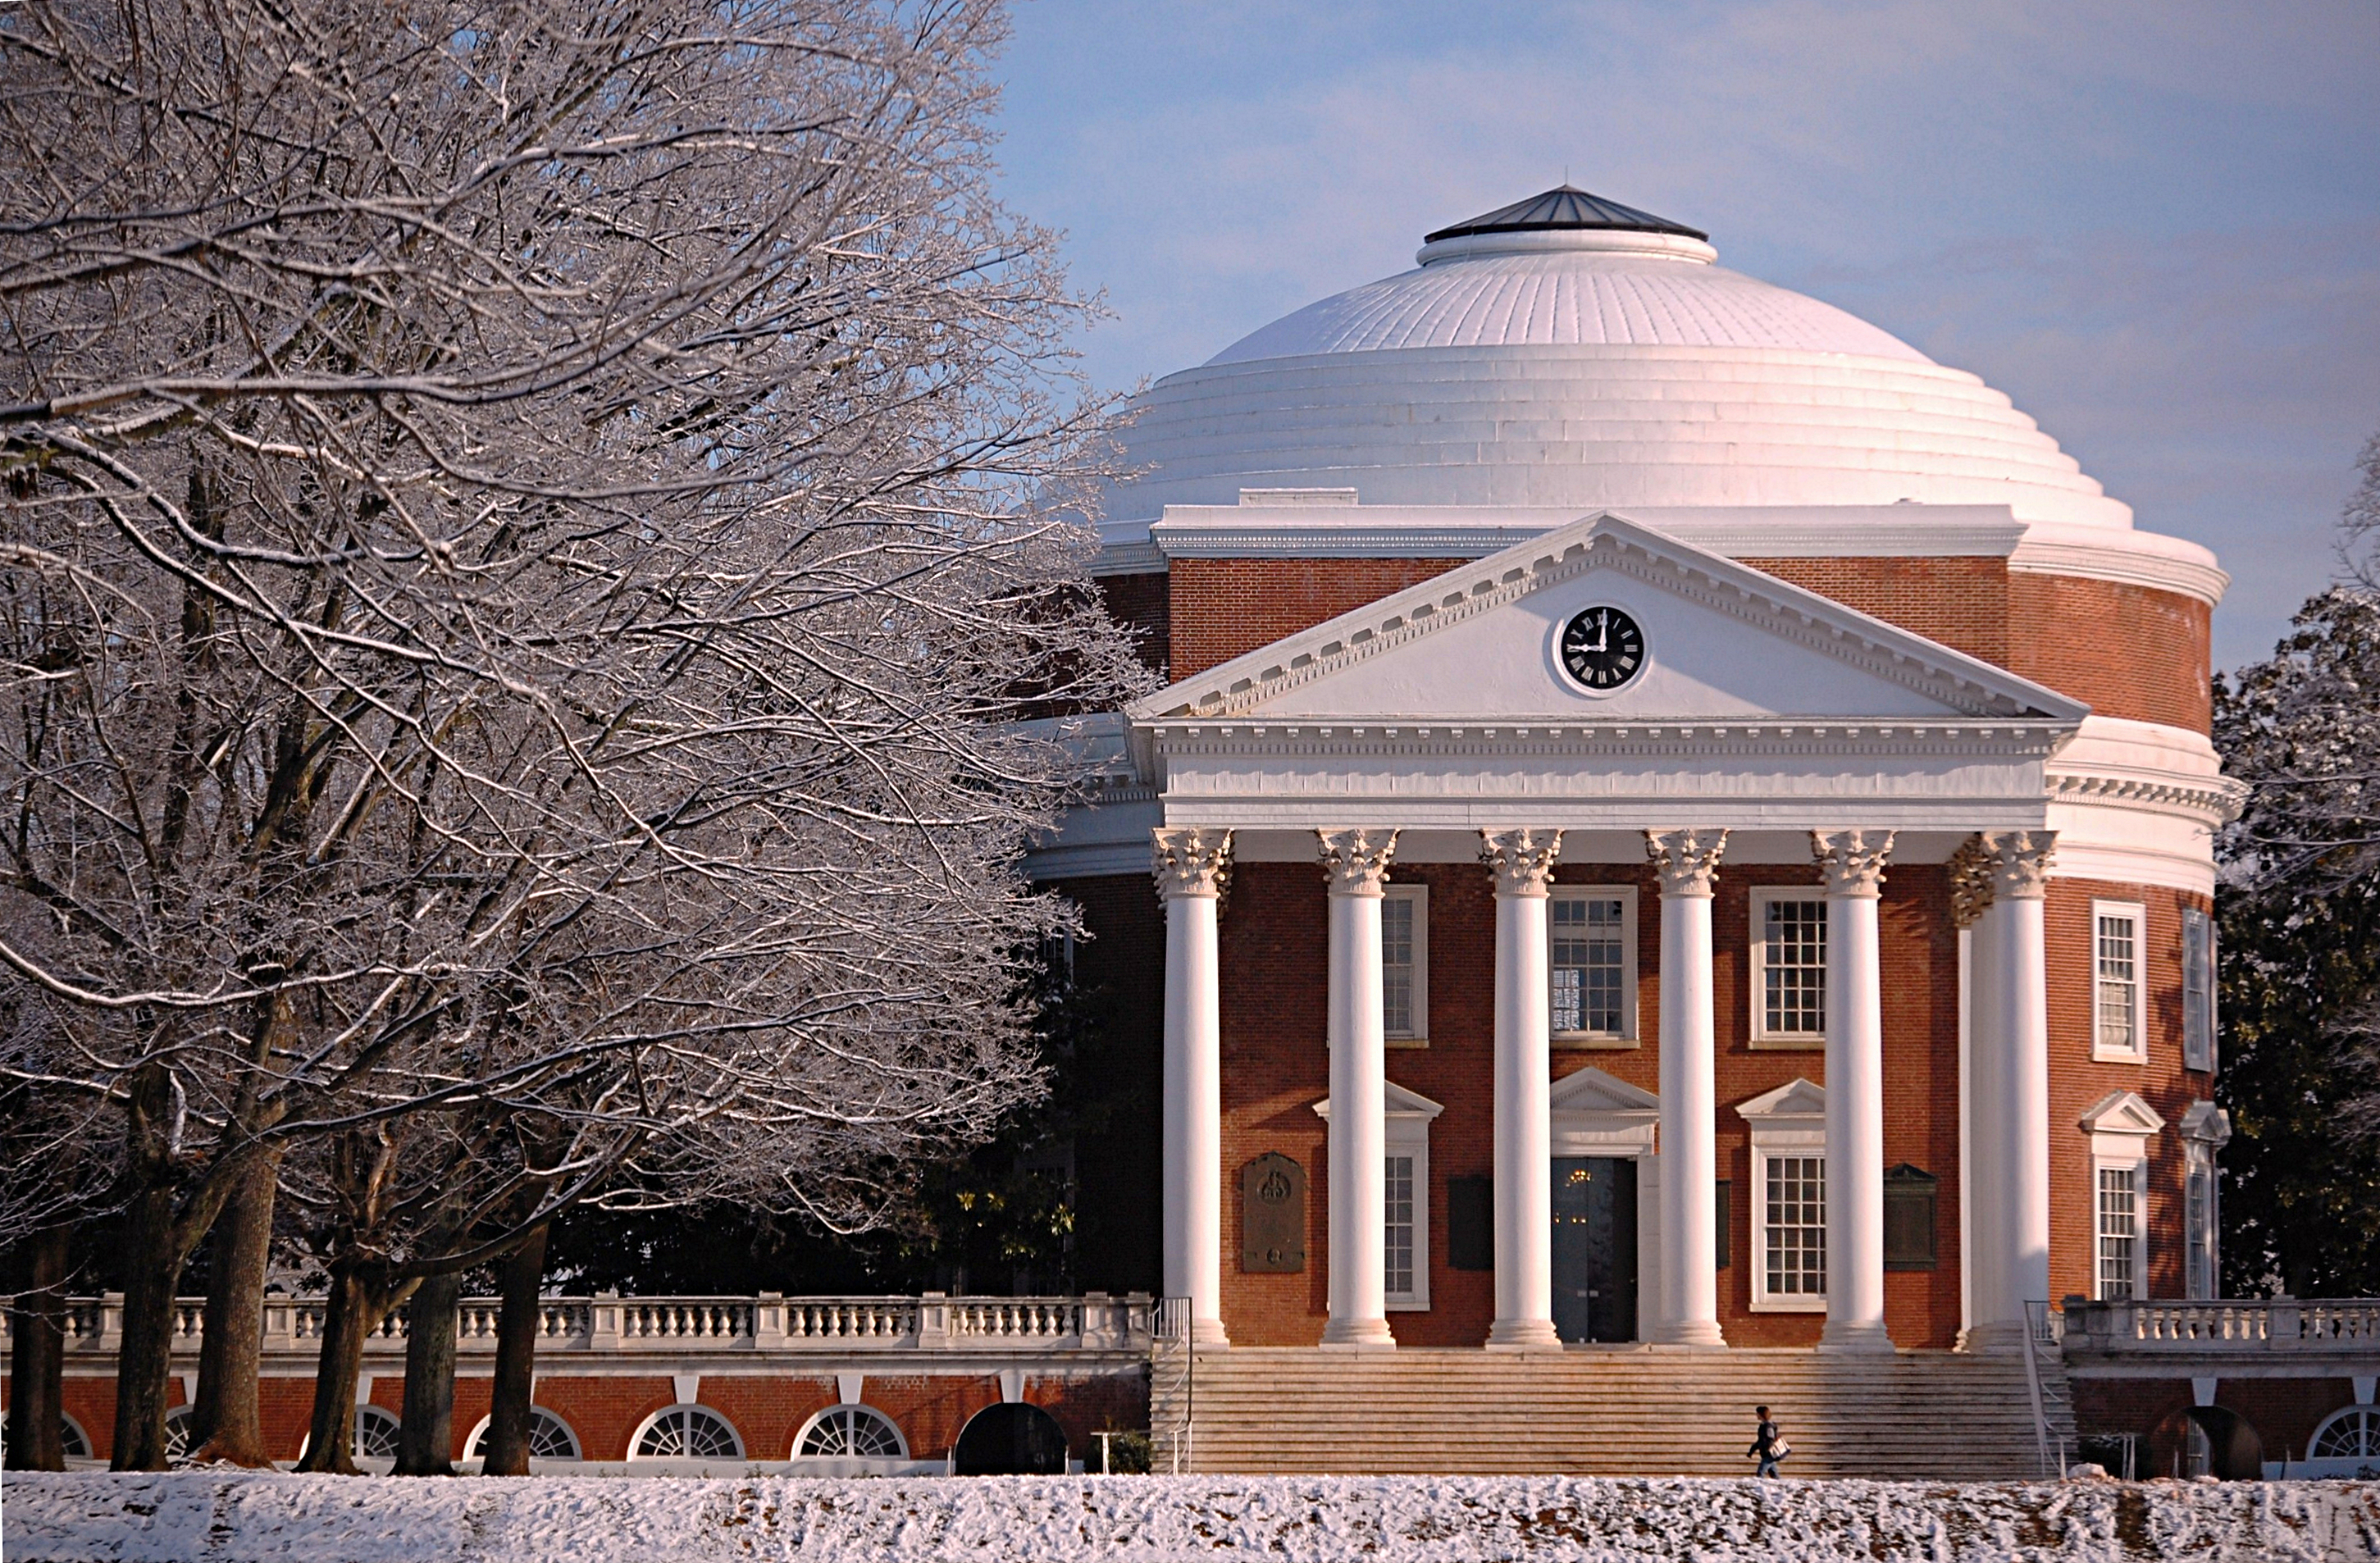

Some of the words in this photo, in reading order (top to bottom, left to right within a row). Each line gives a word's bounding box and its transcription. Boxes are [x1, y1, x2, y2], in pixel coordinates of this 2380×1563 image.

[1582, 617, 1594, 631] XI
[1613, 618, 1621, 629] I
[1571, 629, 1584, 640] X
[1621, 629, 1634, 640] II
[1570, 656, 1585, 672] VIII
[1581, 666, 1594, 681] VII
[1598, 671, 1607, 684] VI
[1612, 668, 1622, 680] V
